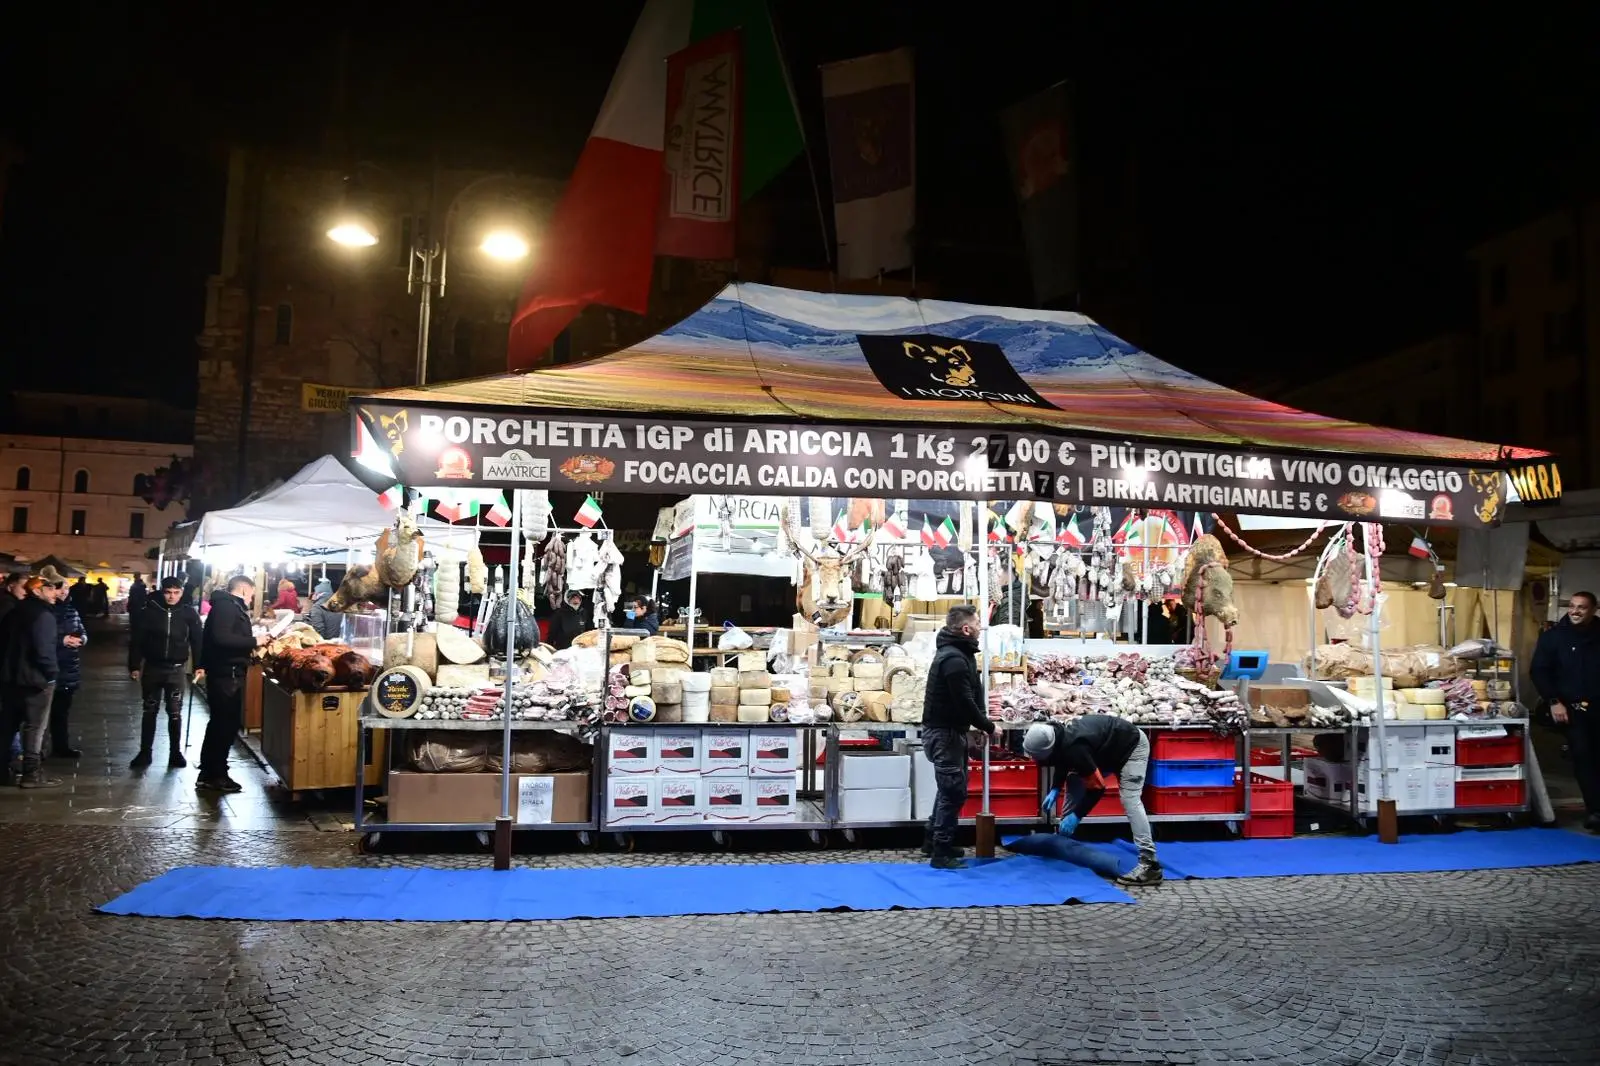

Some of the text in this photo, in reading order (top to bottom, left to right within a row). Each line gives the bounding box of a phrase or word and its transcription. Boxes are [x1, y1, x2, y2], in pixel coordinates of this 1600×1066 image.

[916, 387, 1037, 404] NORCINI
[420, 414, 626, 448] PORCHETTA
[636, 424, 694, 451] IGP
[704, 427, 734, 452] di
[742, 427, 873, 458] ARICCIA
[891, 433, 909, 459] 1
[917, 433, 955, 466] Kg
[1058, 441, 1077, 466] €
[1090, 441, 1137, 471] PIÙ
[1144, 450, 1276, 481] BOTTIGLIA
[1282, 459, 1343, 486] VINO
[1348, 463, 1463, 493] OMAGGIO
[487, 465, 547, 478] AMATRICE
[624, 460, 752, 487] FOCACCIA
[758, 464, 838, 489] CALDA
[844, 467, 894, 490] CON
[902, 470, 1034, 493] PORCHETTA
[1038, 474, 1050, 494] 7
[1056, 475, 1070, 496] €
[1092, 478, 1159, 502] BIRRA
[1163, 482, 1294, 510] ARTIGIANALE
[1299, 492, 1311, 512] 5
[1315, 493, 1328, 512] €
[709, 495, 780, 521] NRCIA
